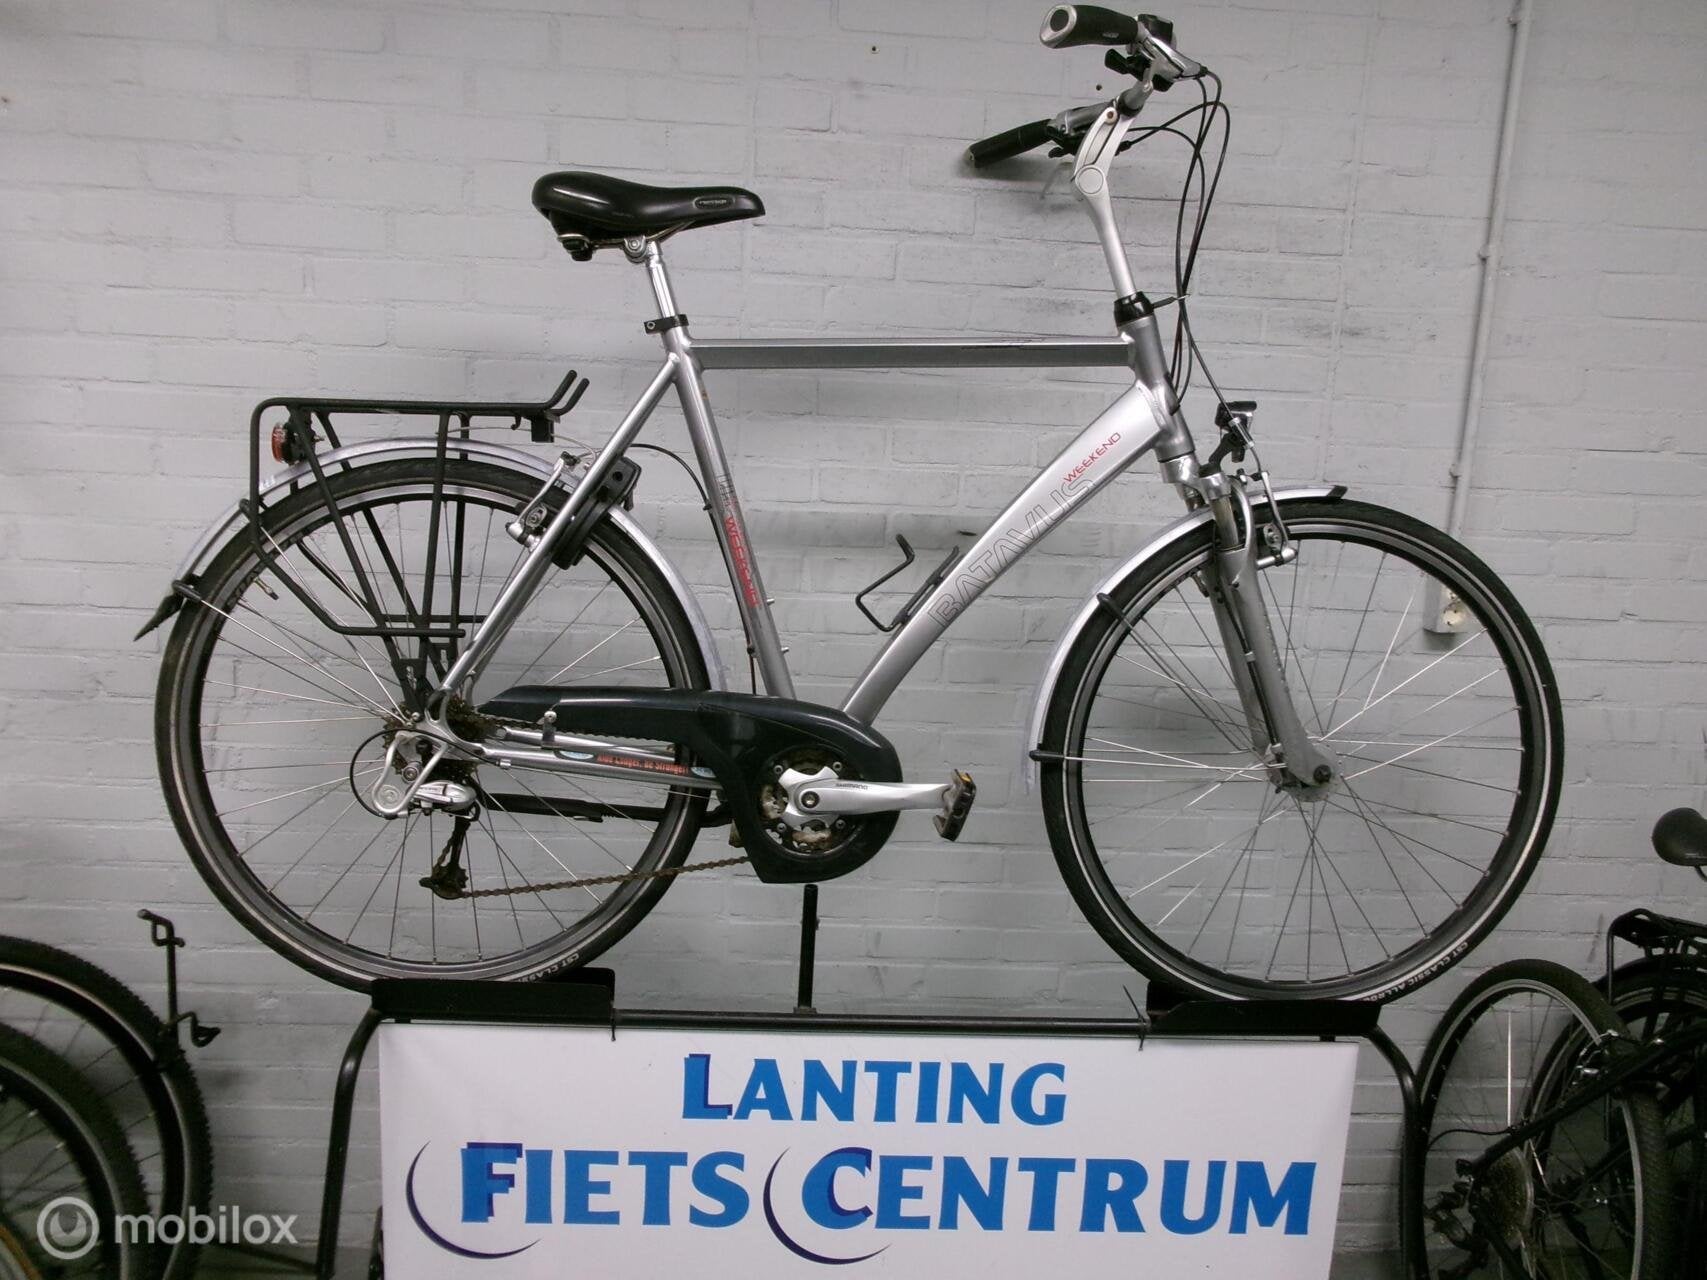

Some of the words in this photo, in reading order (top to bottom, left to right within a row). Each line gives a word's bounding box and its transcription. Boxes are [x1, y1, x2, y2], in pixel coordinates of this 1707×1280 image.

[1062, 432, 1122, 484] WEEKEND
[928, 478, 1096, 628] BATAVUS
[1407, 956, 1451, 986] CLASSIC
[682, 1054, 1068, 1127] LANTING
[461, 1142, 750, 1229] FIETS
[801, 1147, 1318, 1237] CENTRUM
